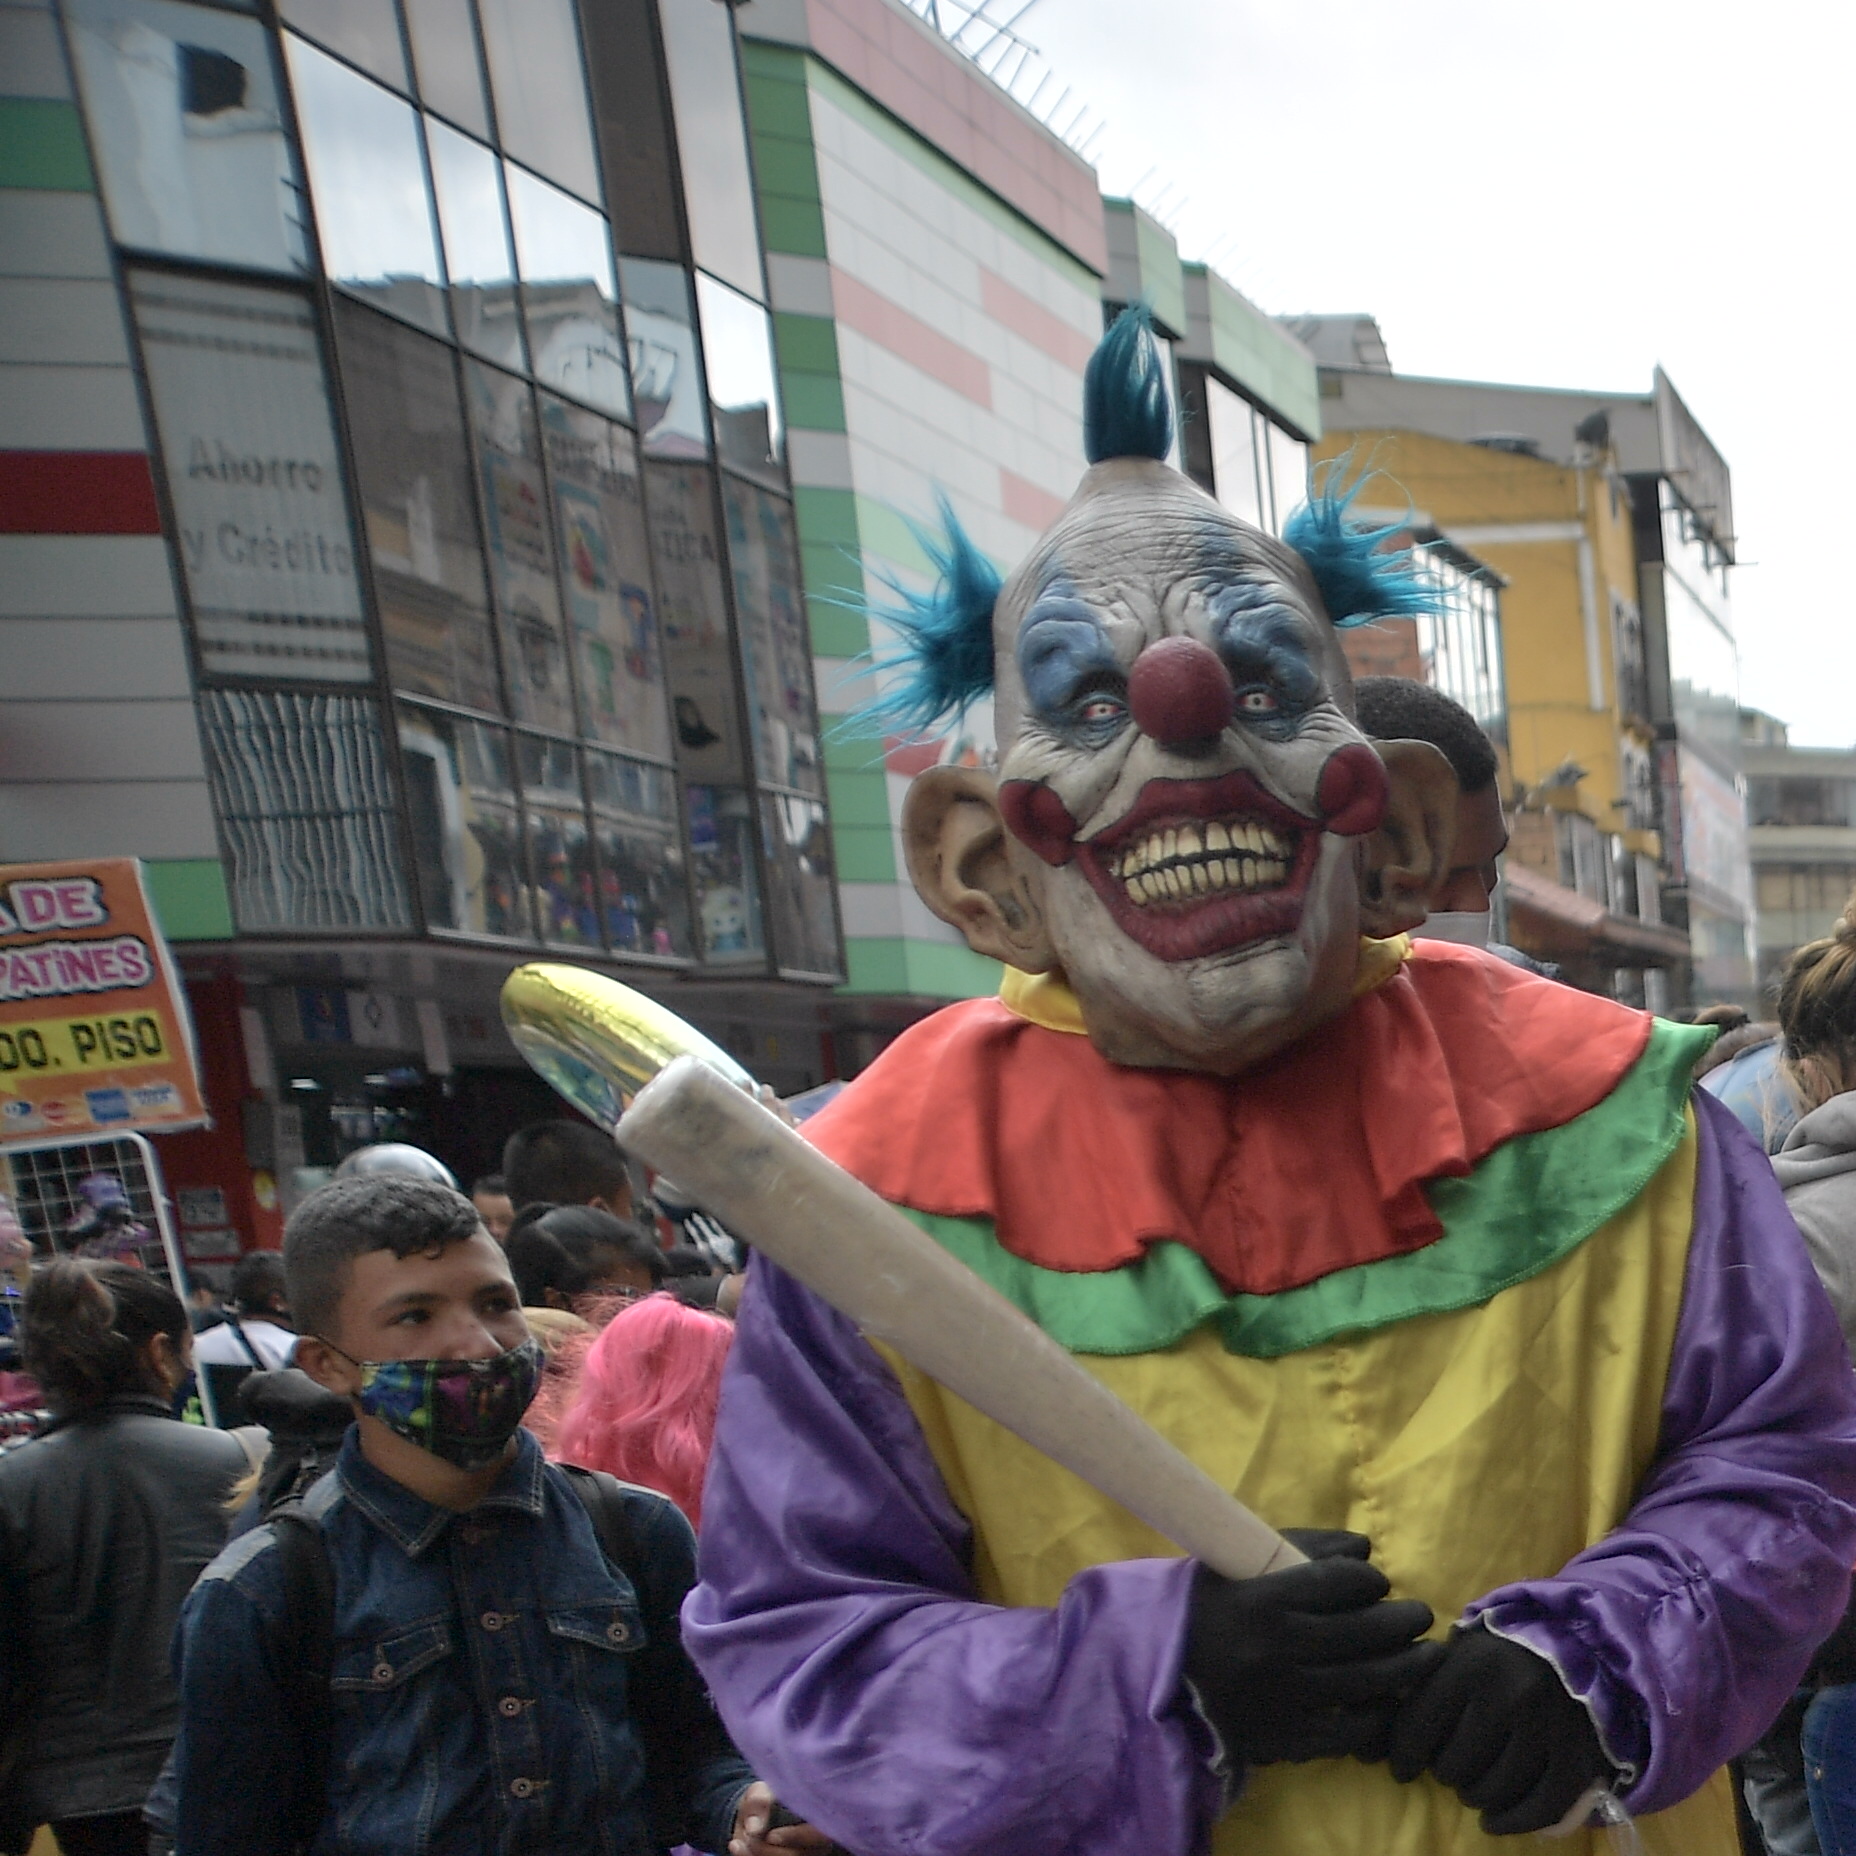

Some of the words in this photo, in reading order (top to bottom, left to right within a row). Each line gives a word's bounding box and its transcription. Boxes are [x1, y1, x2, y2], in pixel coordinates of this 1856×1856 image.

[189, 436, 322, 492] Ahorro
[13, 882, 99, 927] DE
[69, 1016, 160, 1063] PISO
